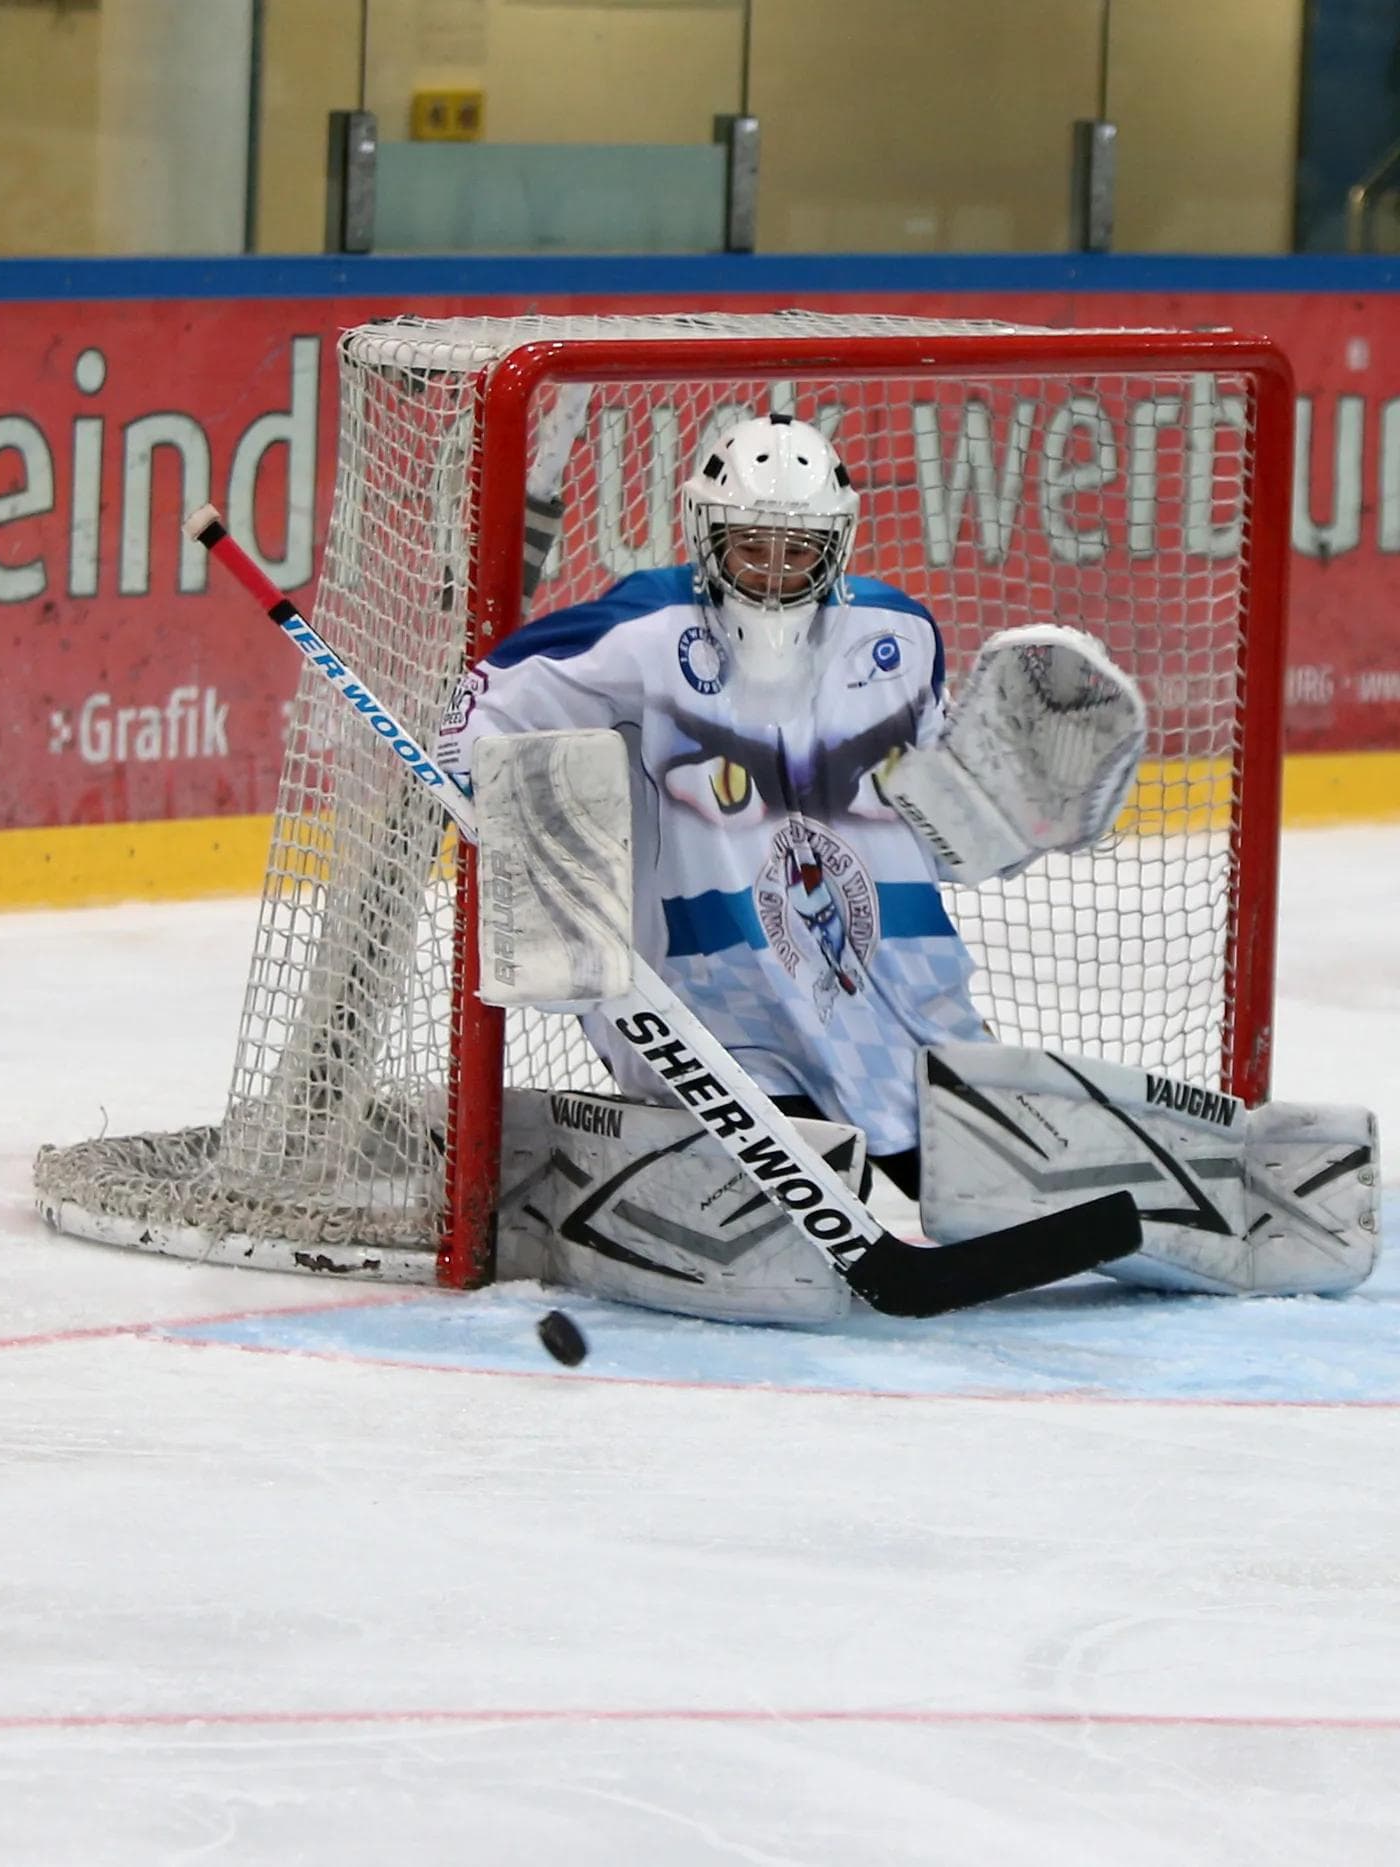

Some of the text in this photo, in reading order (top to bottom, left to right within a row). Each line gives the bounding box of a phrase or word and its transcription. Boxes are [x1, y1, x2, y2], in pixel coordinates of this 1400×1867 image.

[78, 685, 230, 765] Grafik
[281, 614, 445, 788] ER-WOOD
[550, 1094, 624, 1139] VAUGHN
[1146, 1073, 1237, 1128] VAUGHN
